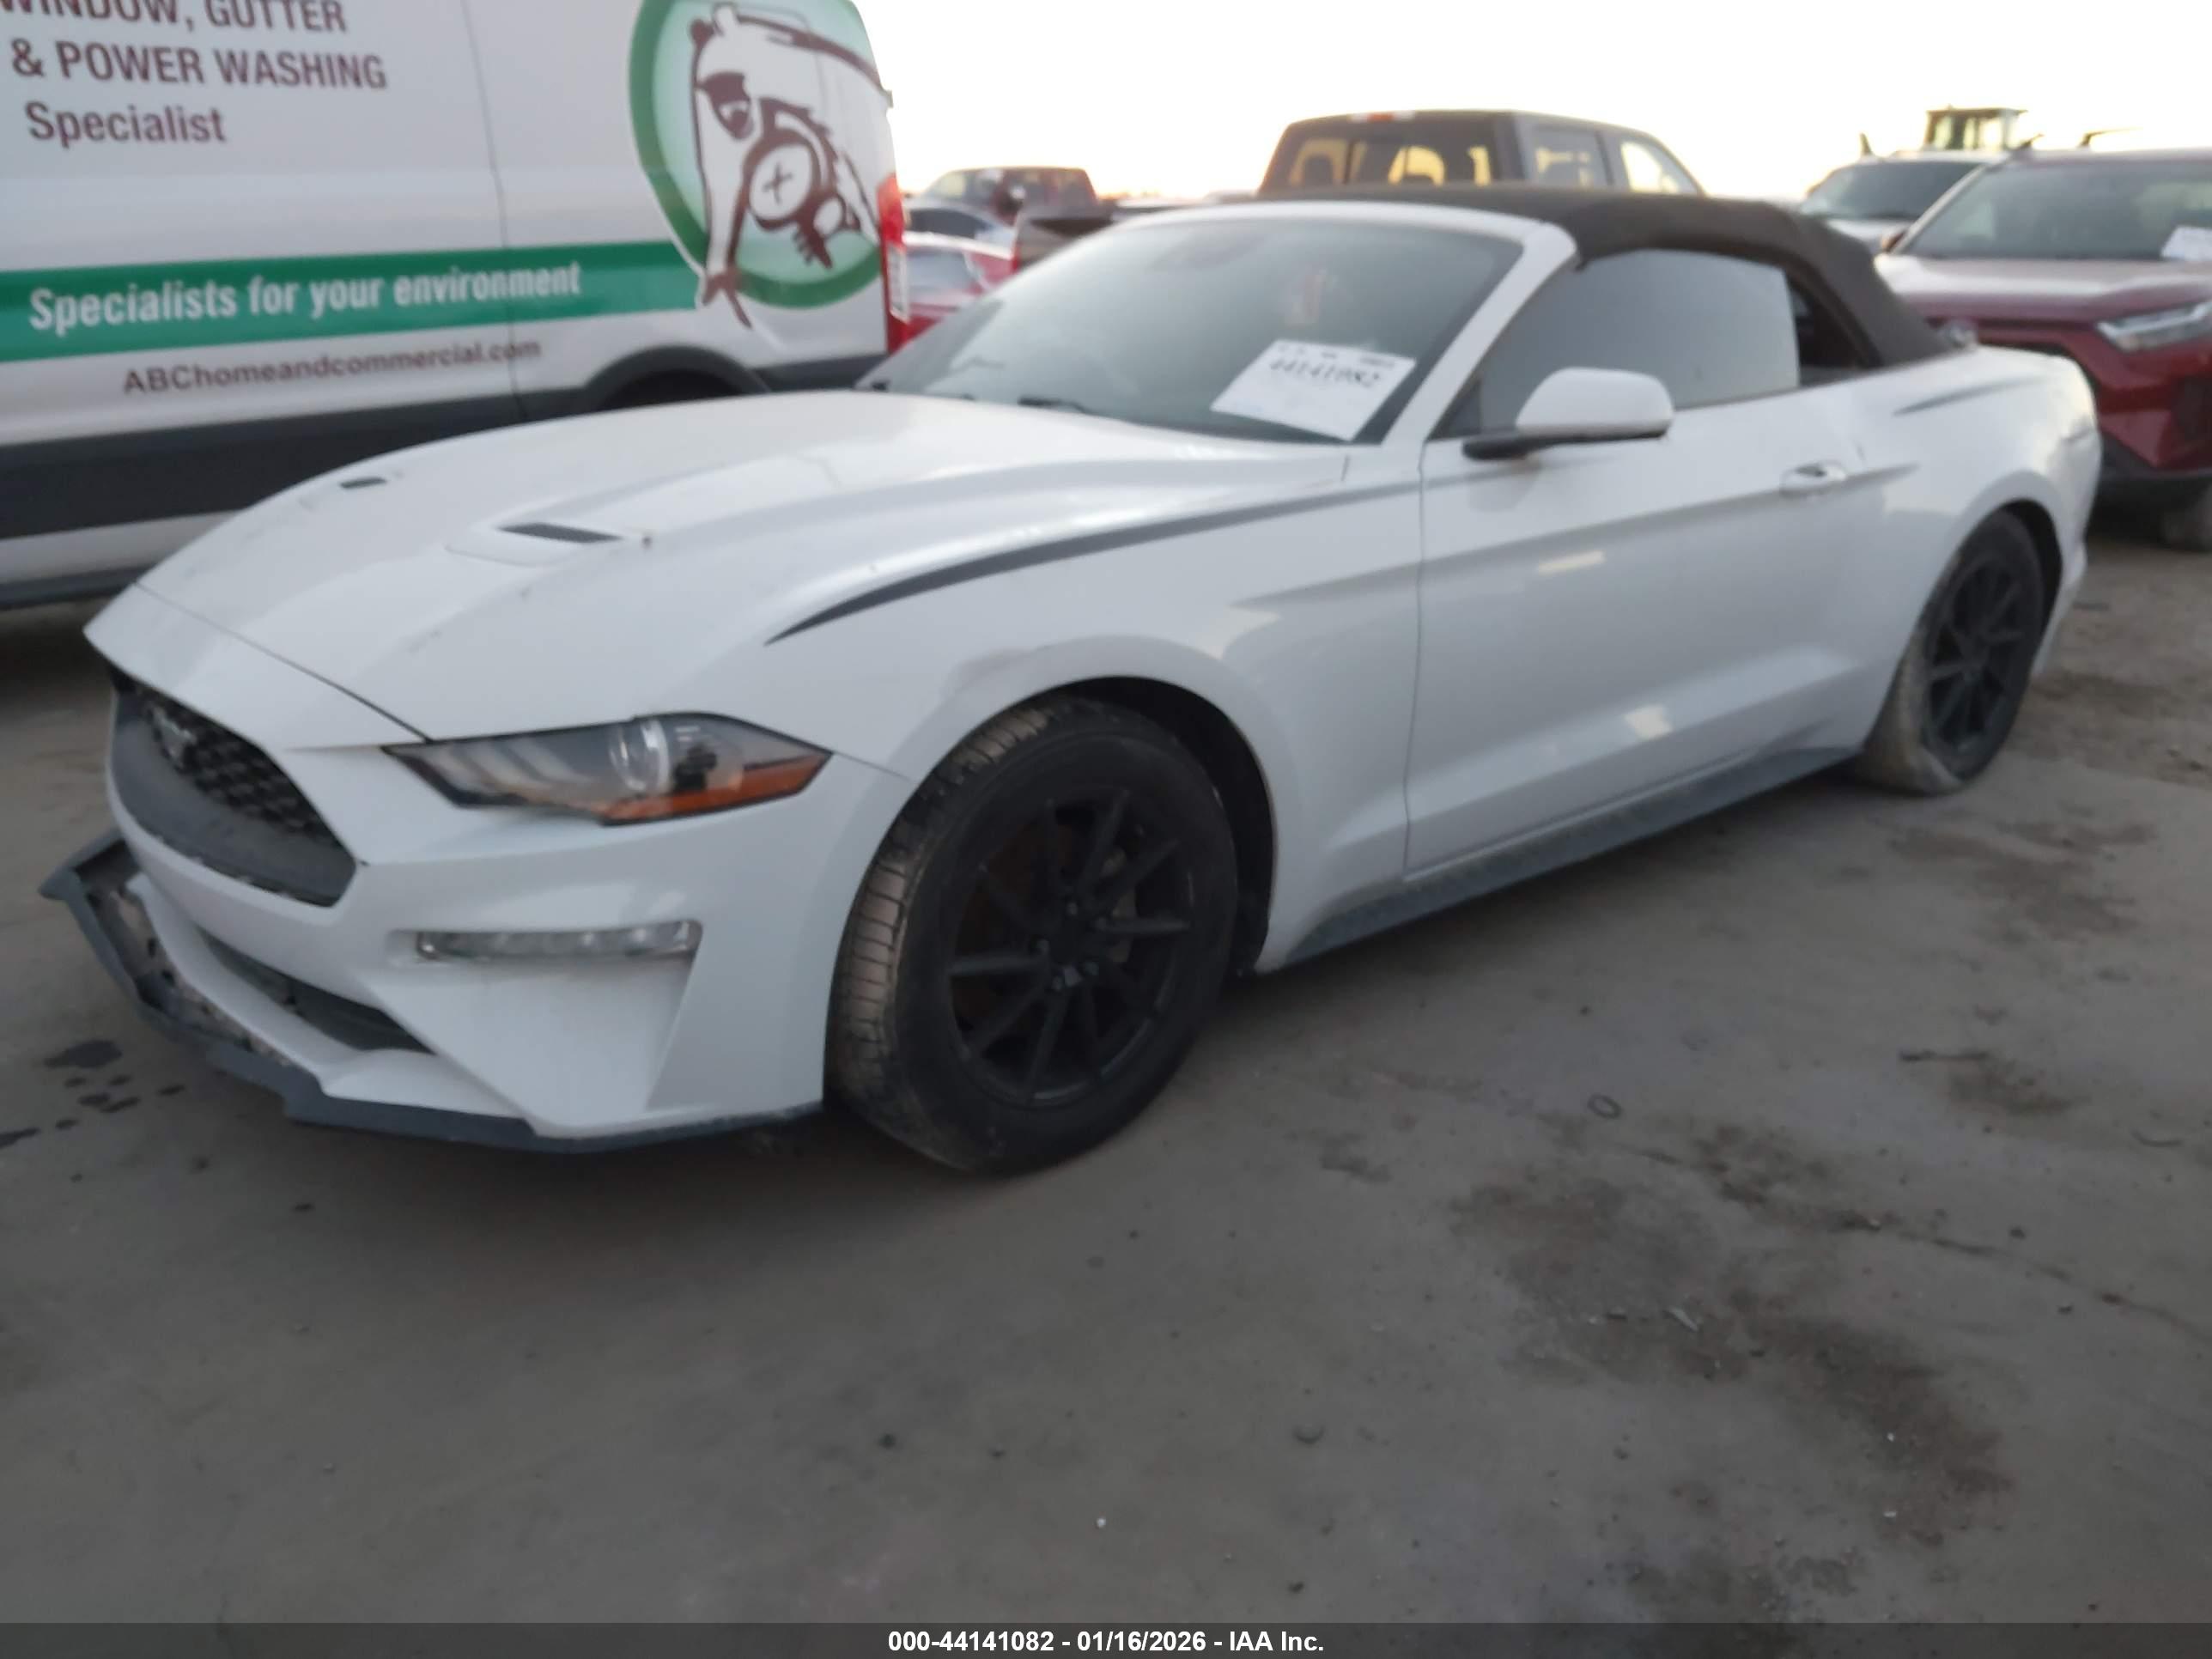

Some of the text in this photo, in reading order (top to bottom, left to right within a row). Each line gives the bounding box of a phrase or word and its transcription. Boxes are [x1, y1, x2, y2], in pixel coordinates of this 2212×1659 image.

[204, 0, 347, 32] GUTTER
[11, 37, 388, 89] & POWER WASHING
[24, 100, 225, 149] Specialist
[28, 260, 581, 337] Specialists for your environment
[123, 340, 542, 394] ABChomeandcommercial.com
